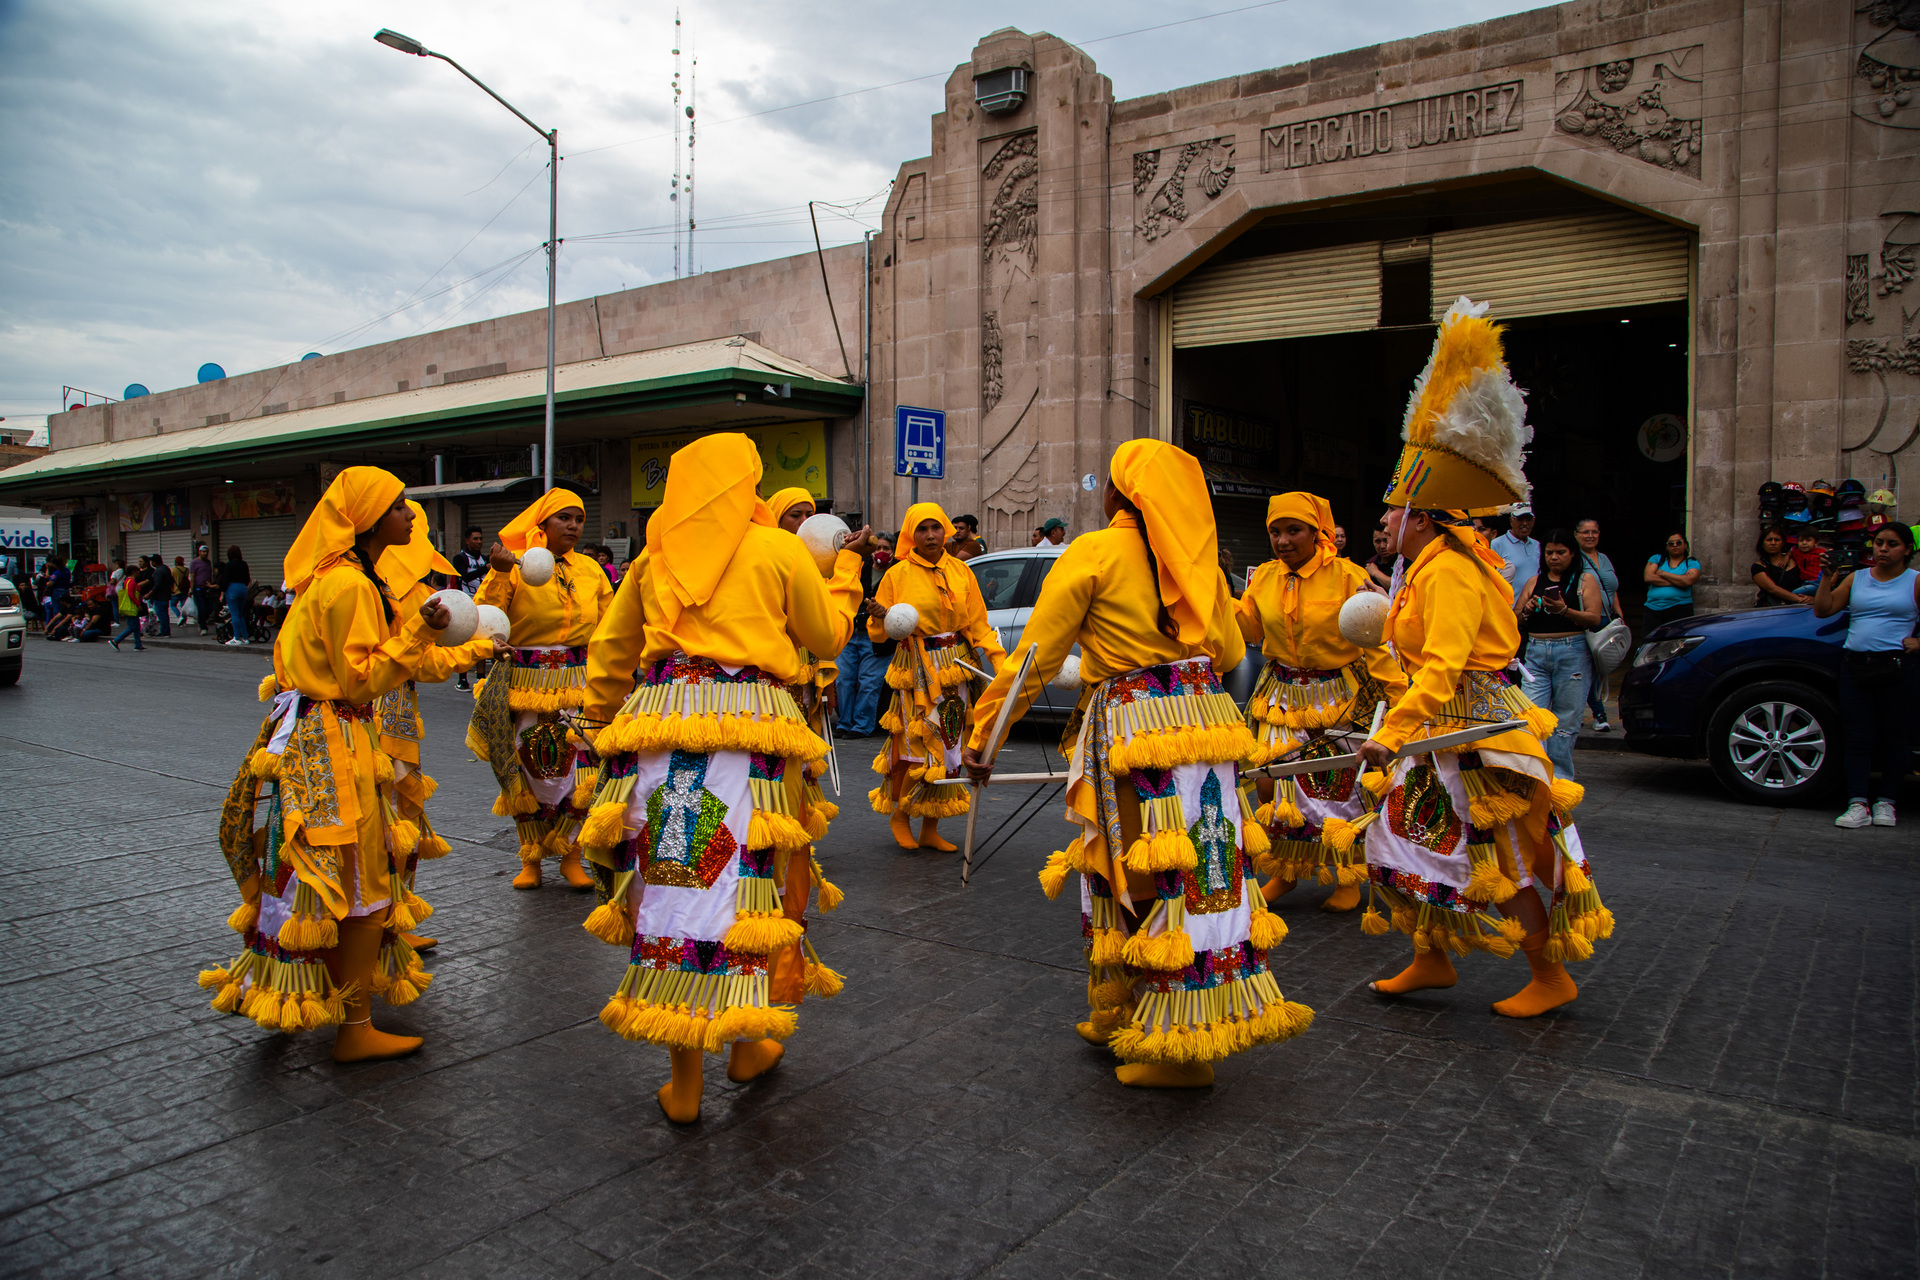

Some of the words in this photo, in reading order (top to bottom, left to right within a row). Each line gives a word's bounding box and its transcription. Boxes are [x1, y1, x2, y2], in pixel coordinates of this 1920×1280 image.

[1264, 107, 1392, 174] MERCADO
[1406, 83, 1520, 149] JUAREZ
[1189, 406, 1274, 454] TABLOIDE
